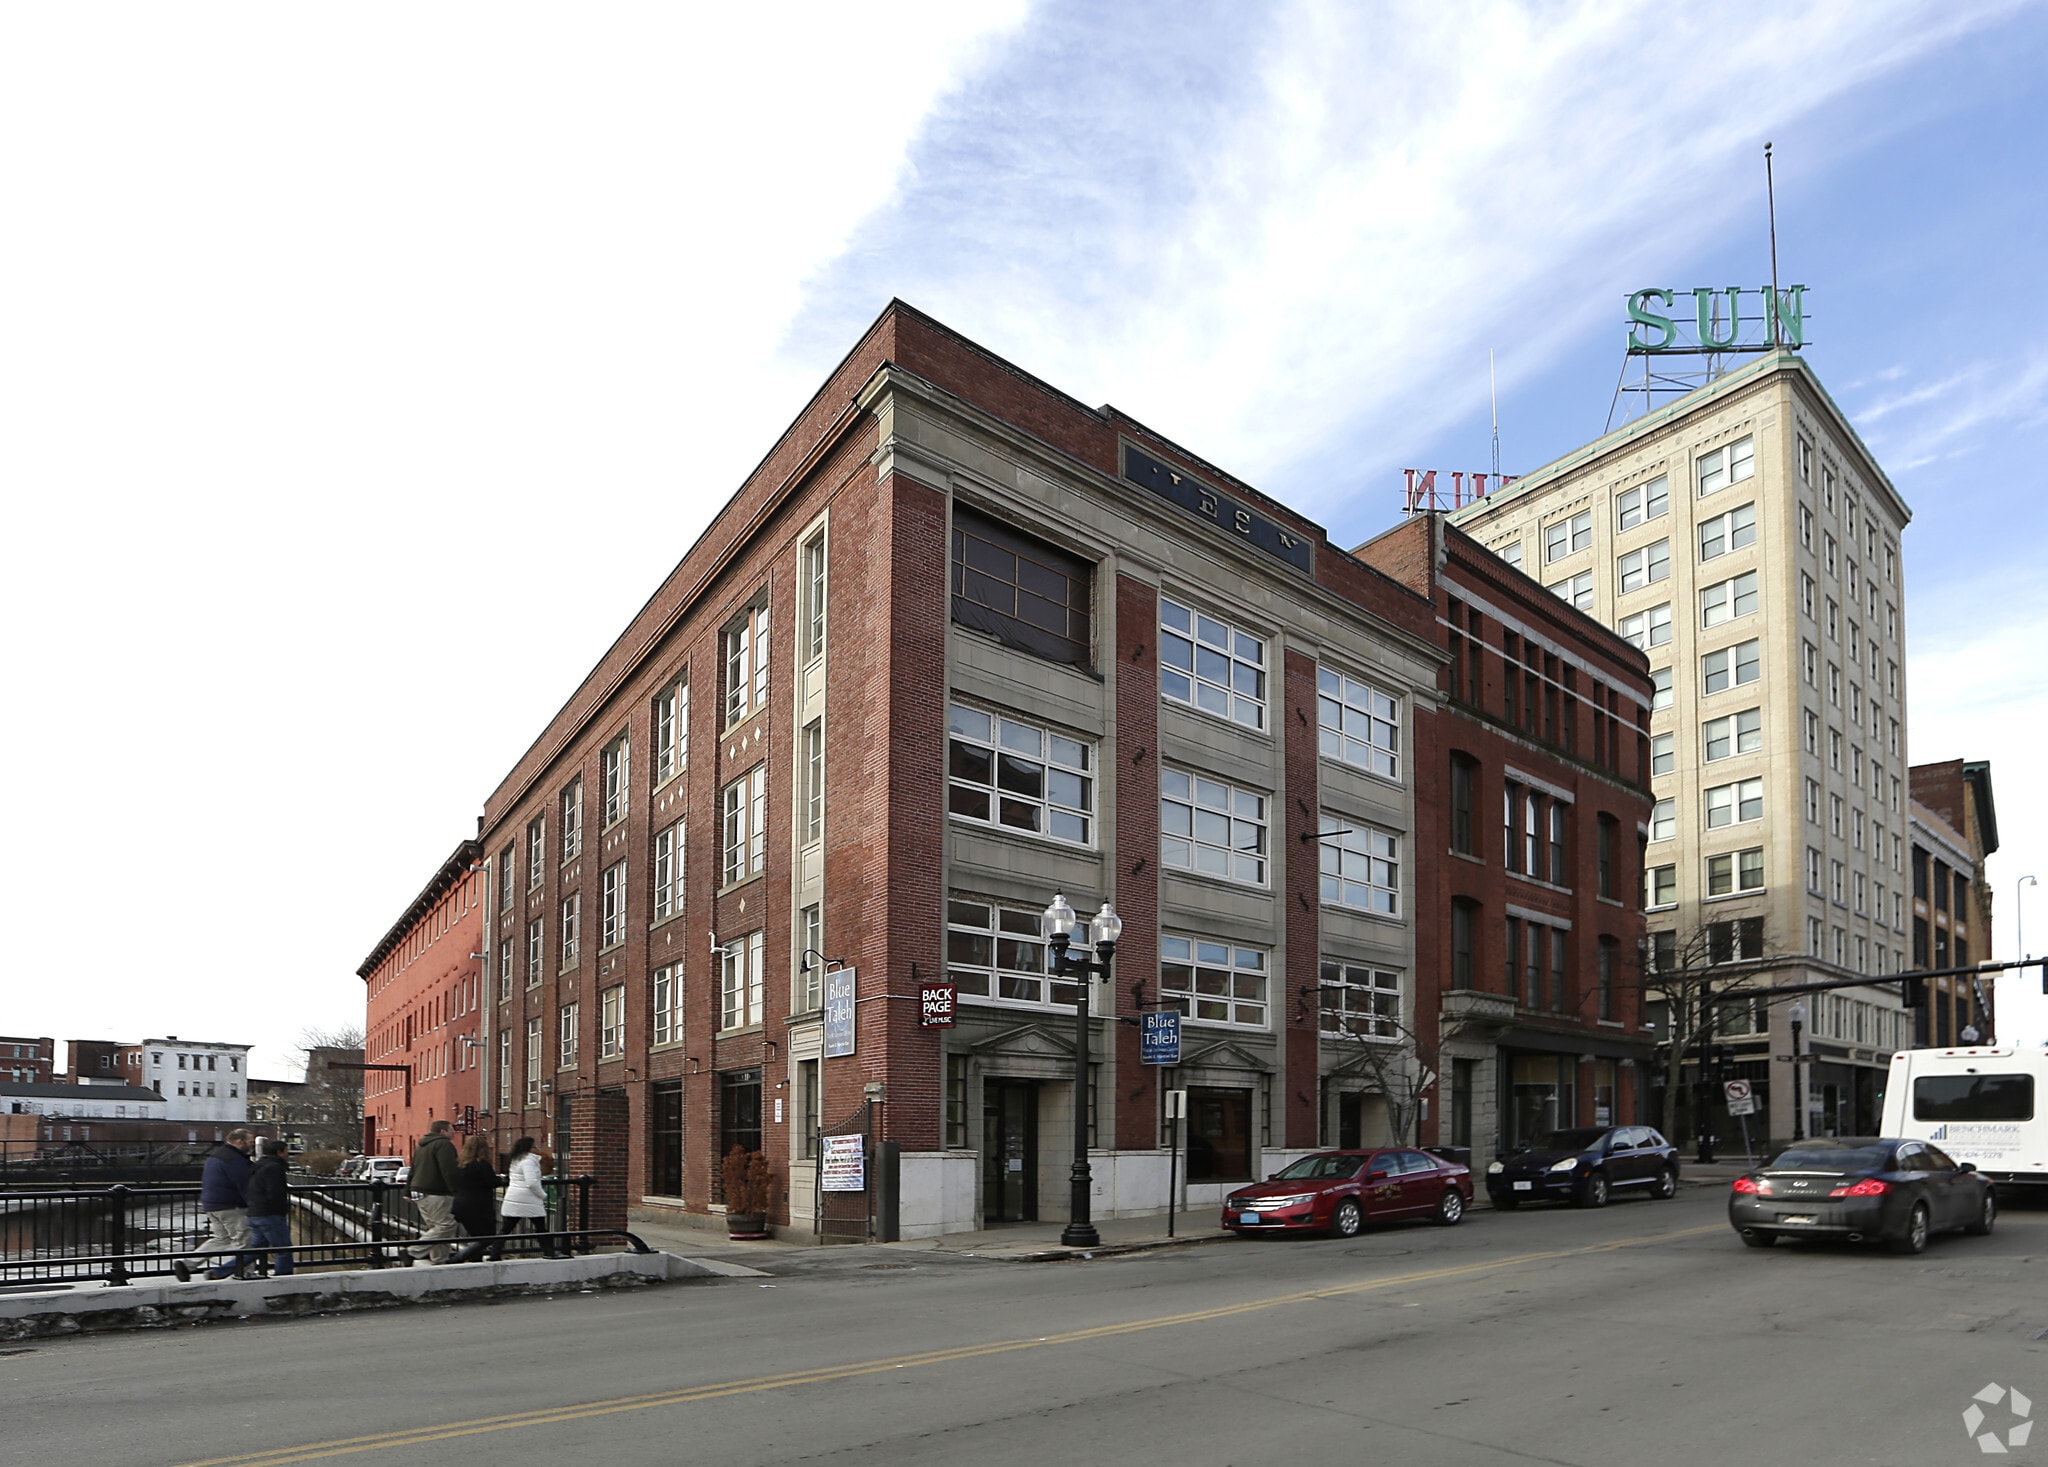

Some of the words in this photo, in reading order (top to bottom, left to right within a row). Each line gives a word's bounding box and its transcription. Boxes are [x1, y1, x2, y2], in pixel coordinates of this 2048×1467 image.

[1626, 285, 1806, 350] SUN
[829, 979, 851, 1000] Blue
[922, 988, 953, 1001] BACK
[826, 1000, 852, 1023] Taleh
[923, 1001, 952, 1013] PAGE
[1147, 1014, 1175, 1028] Blue
[1143, 1030, 1178, 1045] Taleh
[1949, 1124, 2020, 1134] BENCHMARK
